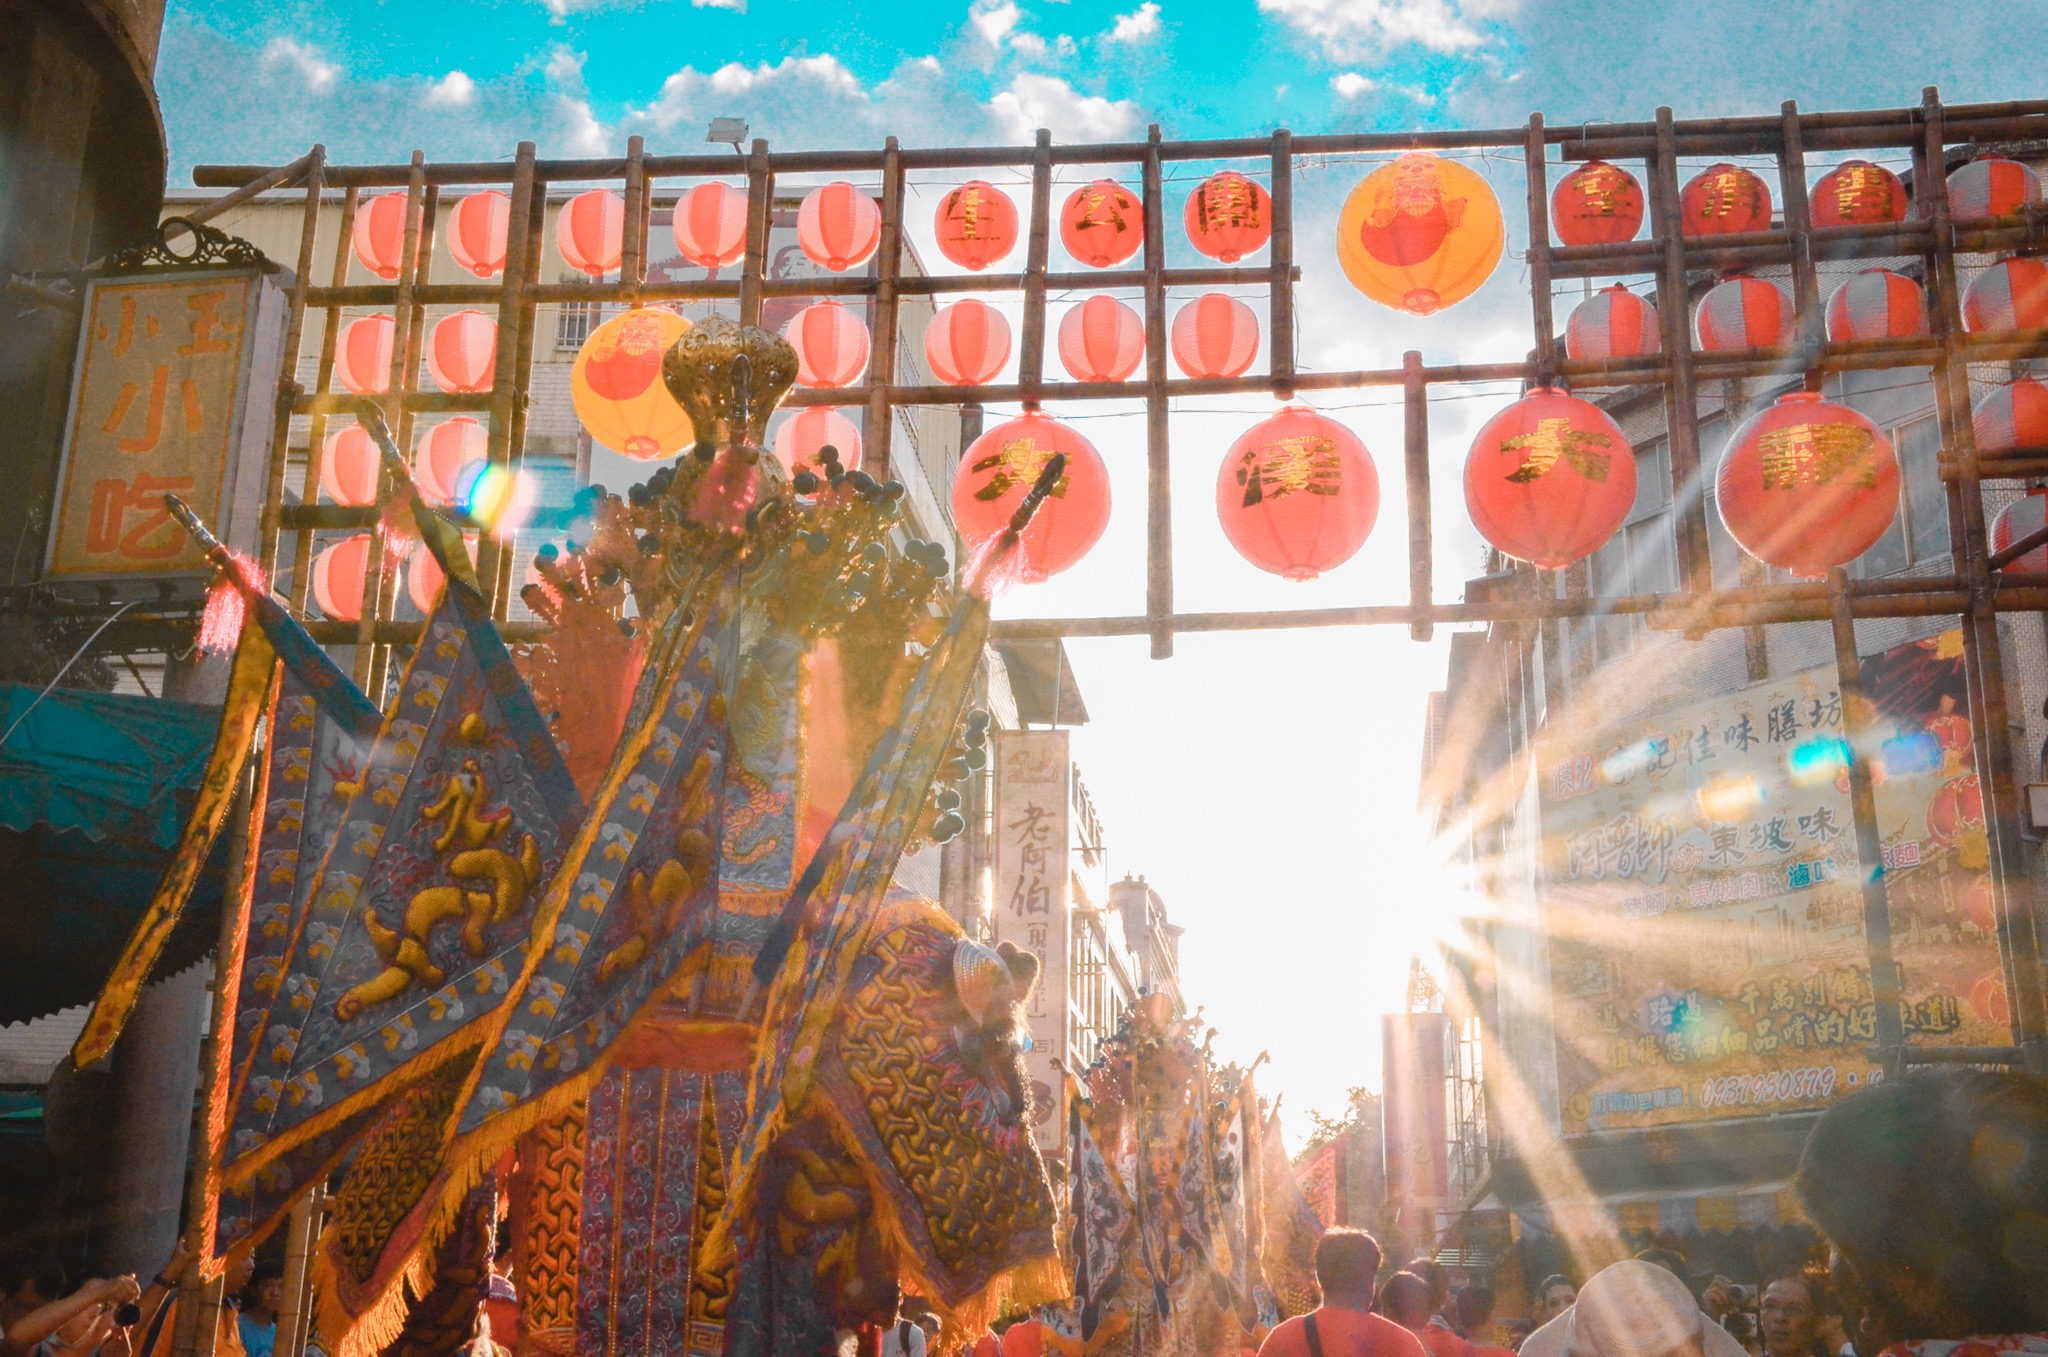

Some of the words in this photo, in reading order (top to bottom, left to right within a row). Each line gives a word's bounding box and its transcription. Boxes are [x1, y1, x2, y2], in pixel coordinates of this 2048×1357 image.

[945, 186, 1001, 243] 生
[1073, 183, 1131, 233] 公
[1500, 417, 1612, 484] 大
[1603, 691, 1842, 786] 記佳味膳坊
[1007, 800, 1058, 918] 老阿伯
